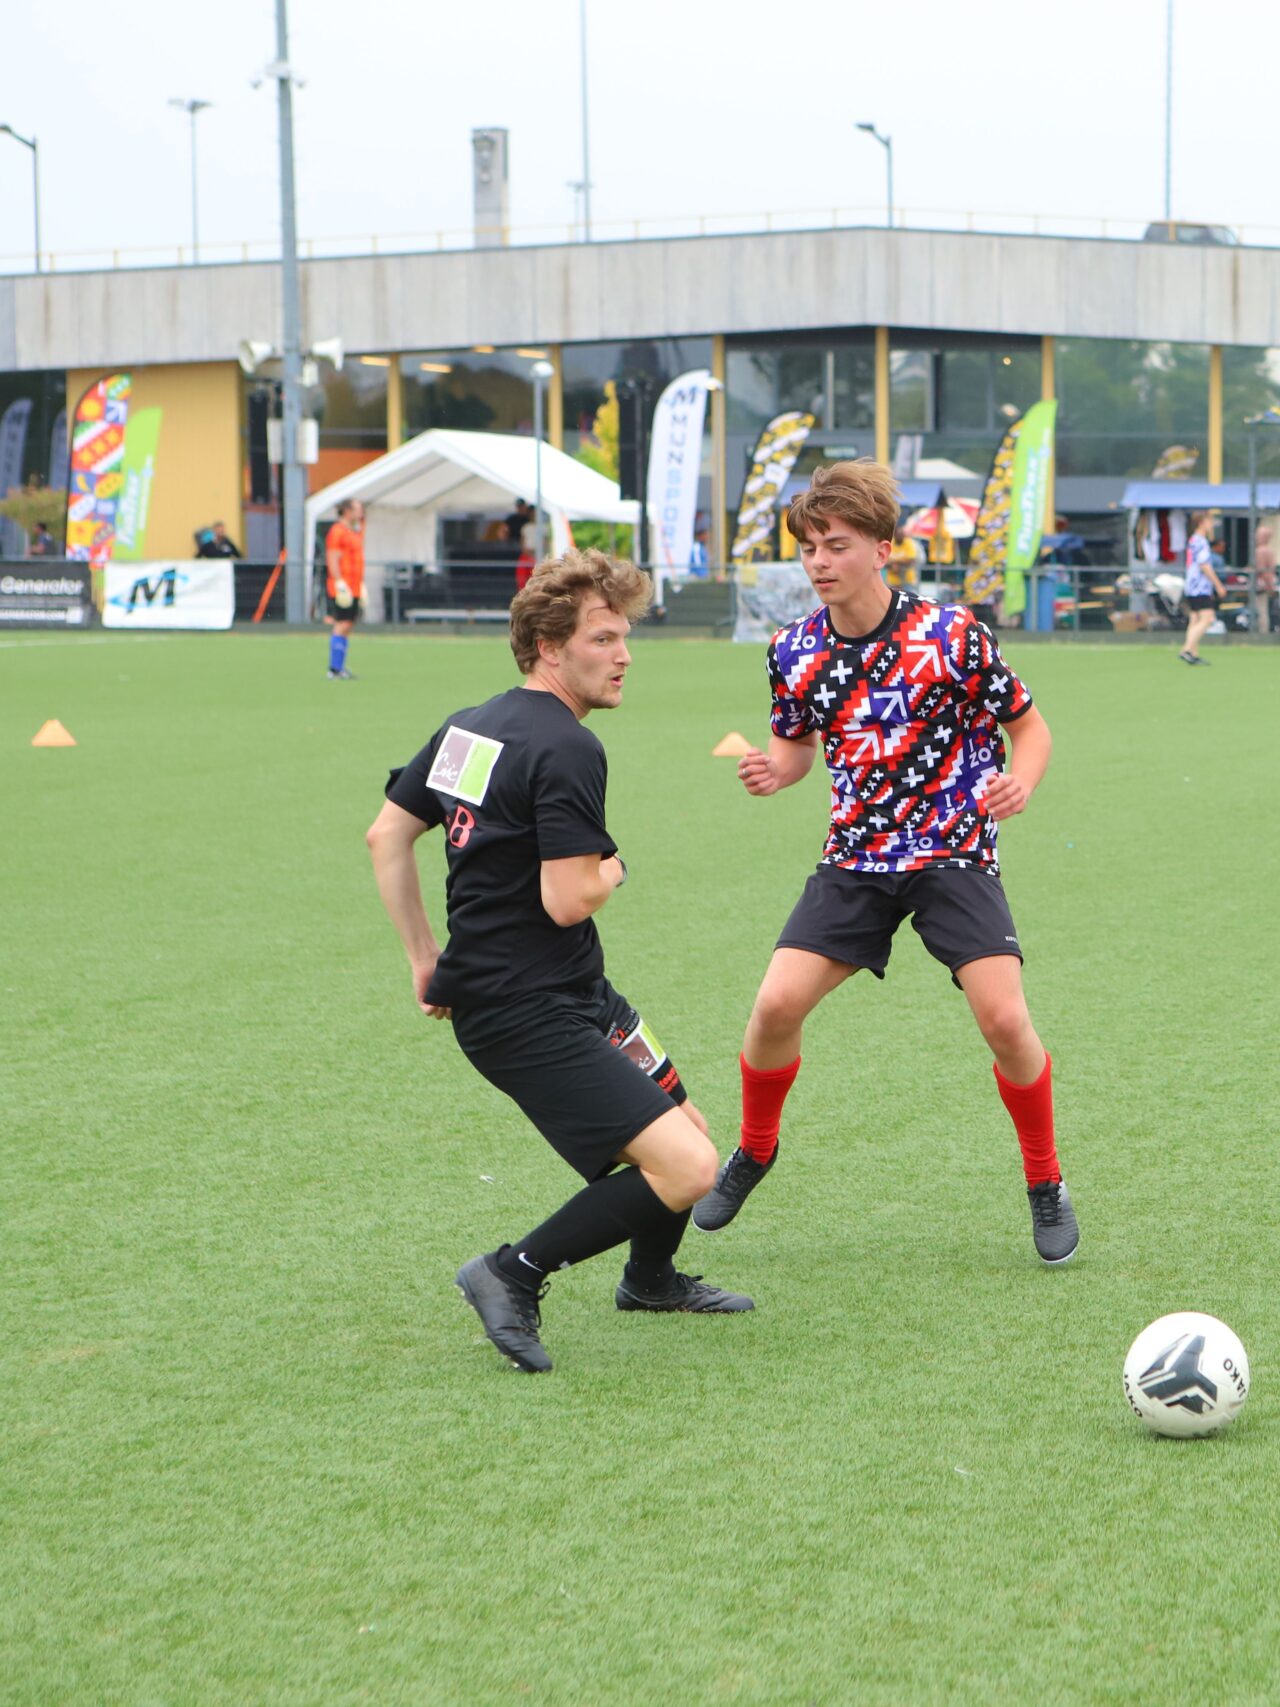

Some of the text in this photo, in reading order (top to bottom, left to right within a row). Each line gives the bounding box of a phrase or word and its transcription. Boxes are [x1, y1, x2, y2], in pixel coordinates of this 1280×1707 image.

[0, 576, 84, 595] Generator
[790, 634, 817, 651] ZO
[968, 746, 992, 769] ZO
[905, 836, 934, 852] ZO
[861, 862, 890, 873] ZO
[1223, 1357, 1247, 1398] JAKO
